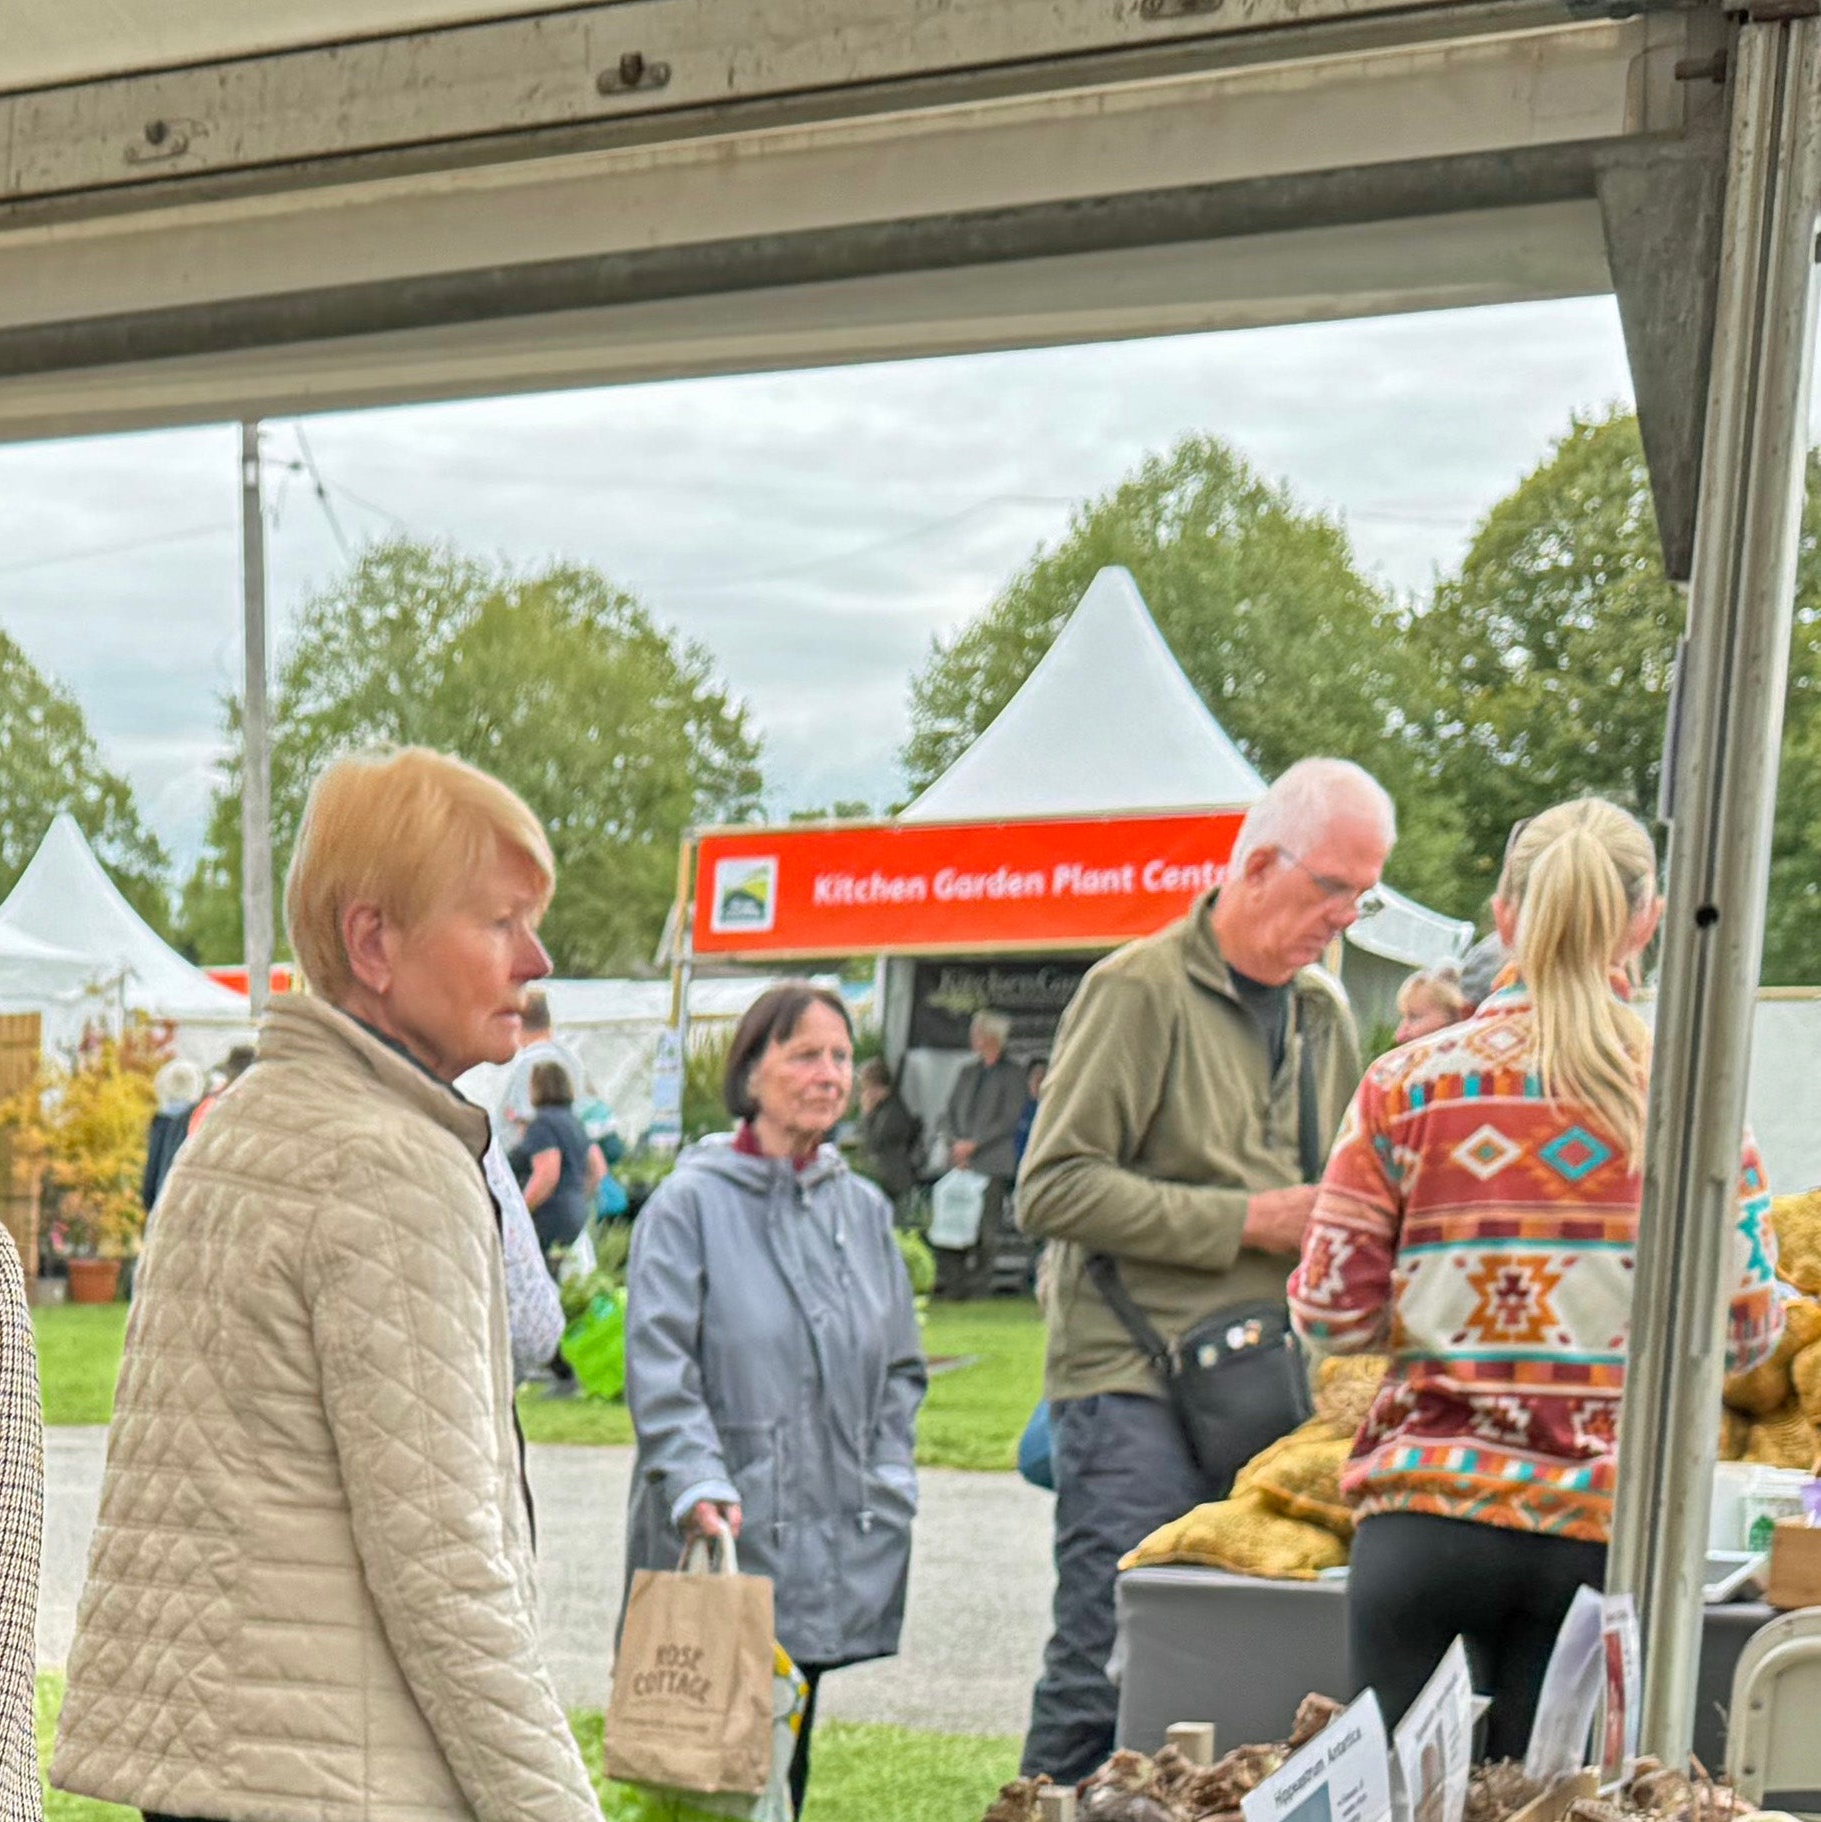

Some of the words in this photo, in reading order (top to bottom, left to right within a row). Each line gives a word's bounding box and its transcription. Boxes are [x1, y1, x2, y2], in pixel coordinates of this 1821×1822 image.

[813, 871, 927, 906] Kitchen
[932, 865, 1045, 901] Garden
[1051, 862, 1133, 898] Plant
[1142, 858, 1227, 894] Centr
[632, 1668, 712, 1704] COTTAGE
